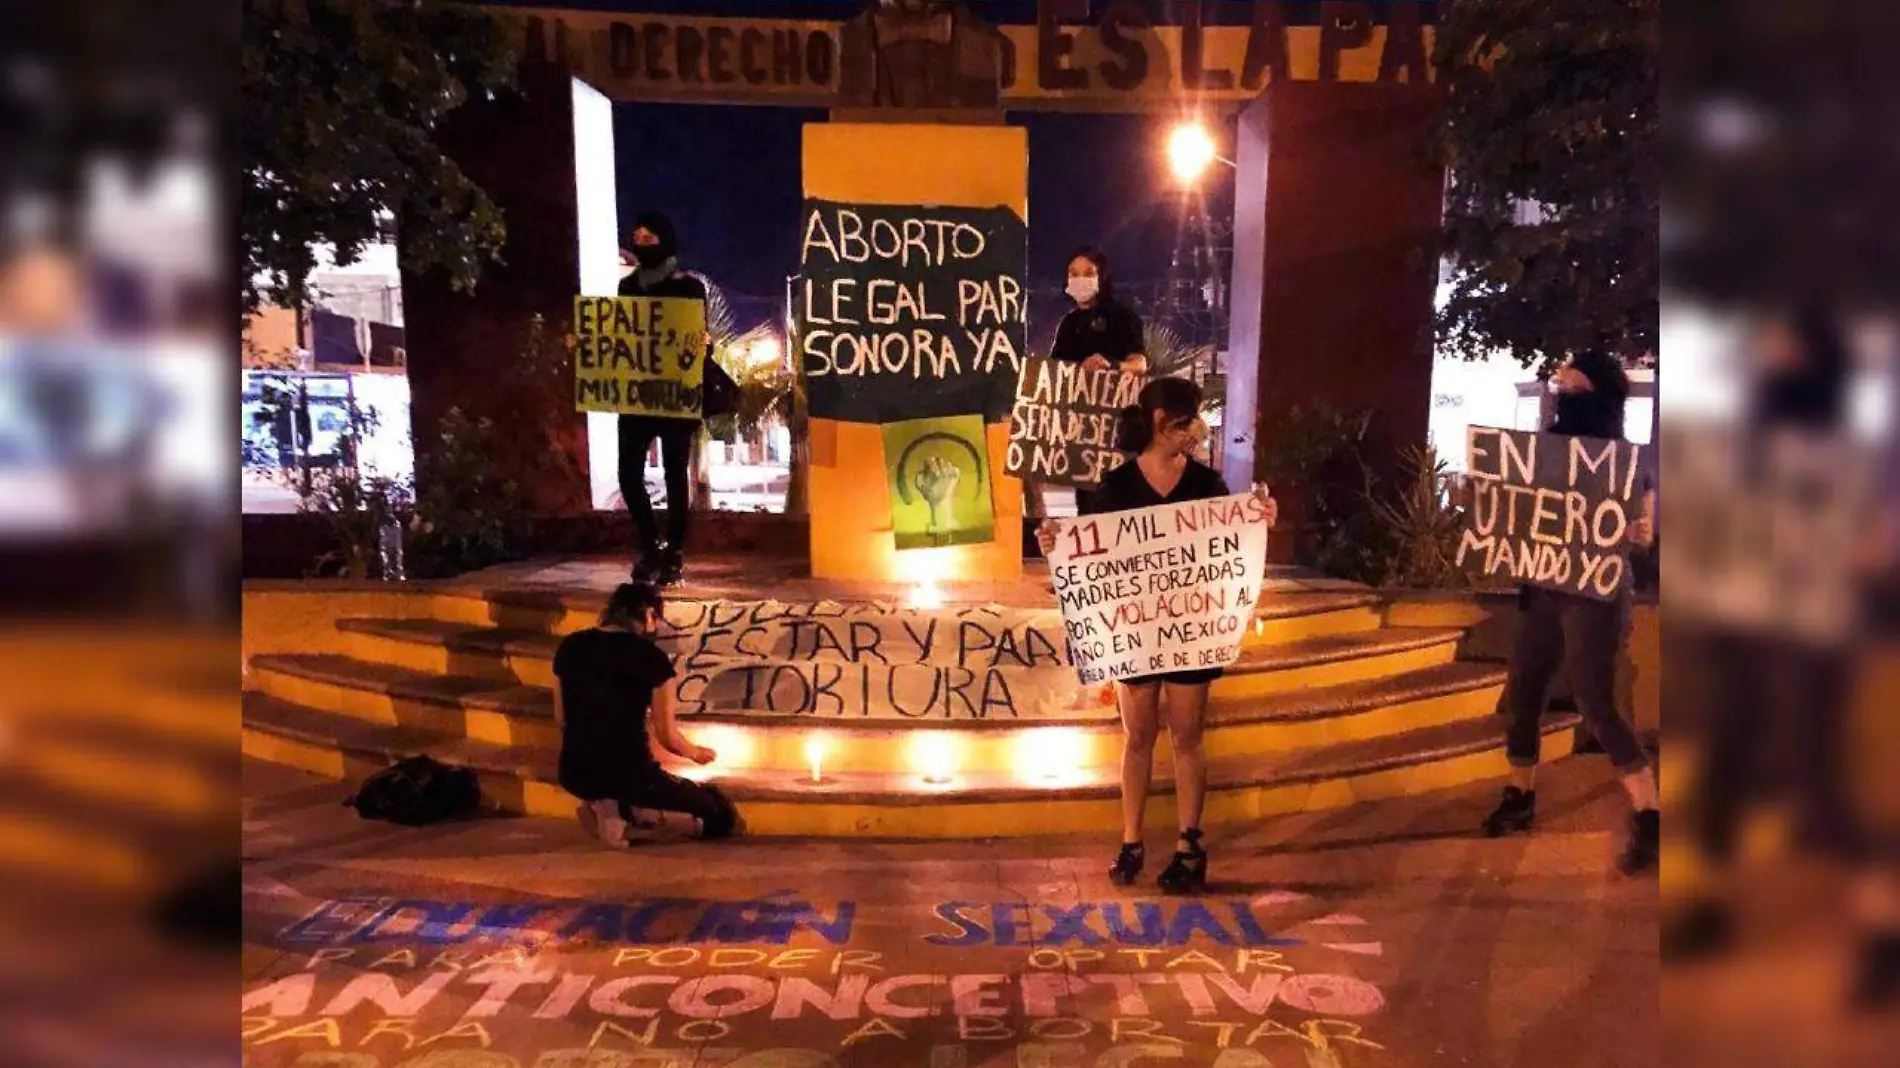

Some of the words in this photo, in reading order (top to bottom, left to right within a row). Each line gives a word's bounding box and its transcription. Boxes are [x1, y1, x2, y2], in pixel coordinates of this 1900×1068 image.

[609, 21, 833, 86] DERECHO
[1319, 0, 1441, 84] PA
[802, 209, 985, 267] ABORTO
[806, 277, 946, 325] LEGAL
[804, 328, 961, 379] SONORA
[966, 328, 1019, 374] YA
[577, 377, 621, 406] MIS
[1007, 442, 1024, 471] O
[1031, 445, 1070, 477] NO
[1467, 427, 1536, 485] EN
[1569, 436, 1639, 501] MI
[1067, 520, 1109, 561] 11
[1116, 514, 1166, 546] MIL
[1175, 499, 1264, 533] NIÑAS
[1055, 565, 1081, 590] SE
[1086, 543, 1197, 583] CONVIERTEN
[1208, 532, 1239, 558] EN
[1060, 576, 1142, 616] MADRES
[1149, 557, 1246, 594] FORZADAS
[1455, 529, 1571, 585] MANDO
[1577, 551, 1623, 595] YO
[1066, 617, 1098, 641] POR
[1236, 586, 1253, 606] AL
[902, 618, 938, 666] Y
[1074, 641, 1105, 668] AÑO
[1113, 631, 1143, 654] EN
[1158, 615, 1238, 648] MEXICO
[1109, 659, 1138, 677] NAC
[1149, 653, 1165, 670] DE
[1173, 651, 1191, 667] DE
[923, 900, 1308, 947] SEXUAL
[613, 946, 886, 974] PODER
[1027, 947, 1296, 973] OPTAR
[242, 969, 1386, 1019] ANTICONCEPTIVO
[587, 1016, 731, 1047] NO
